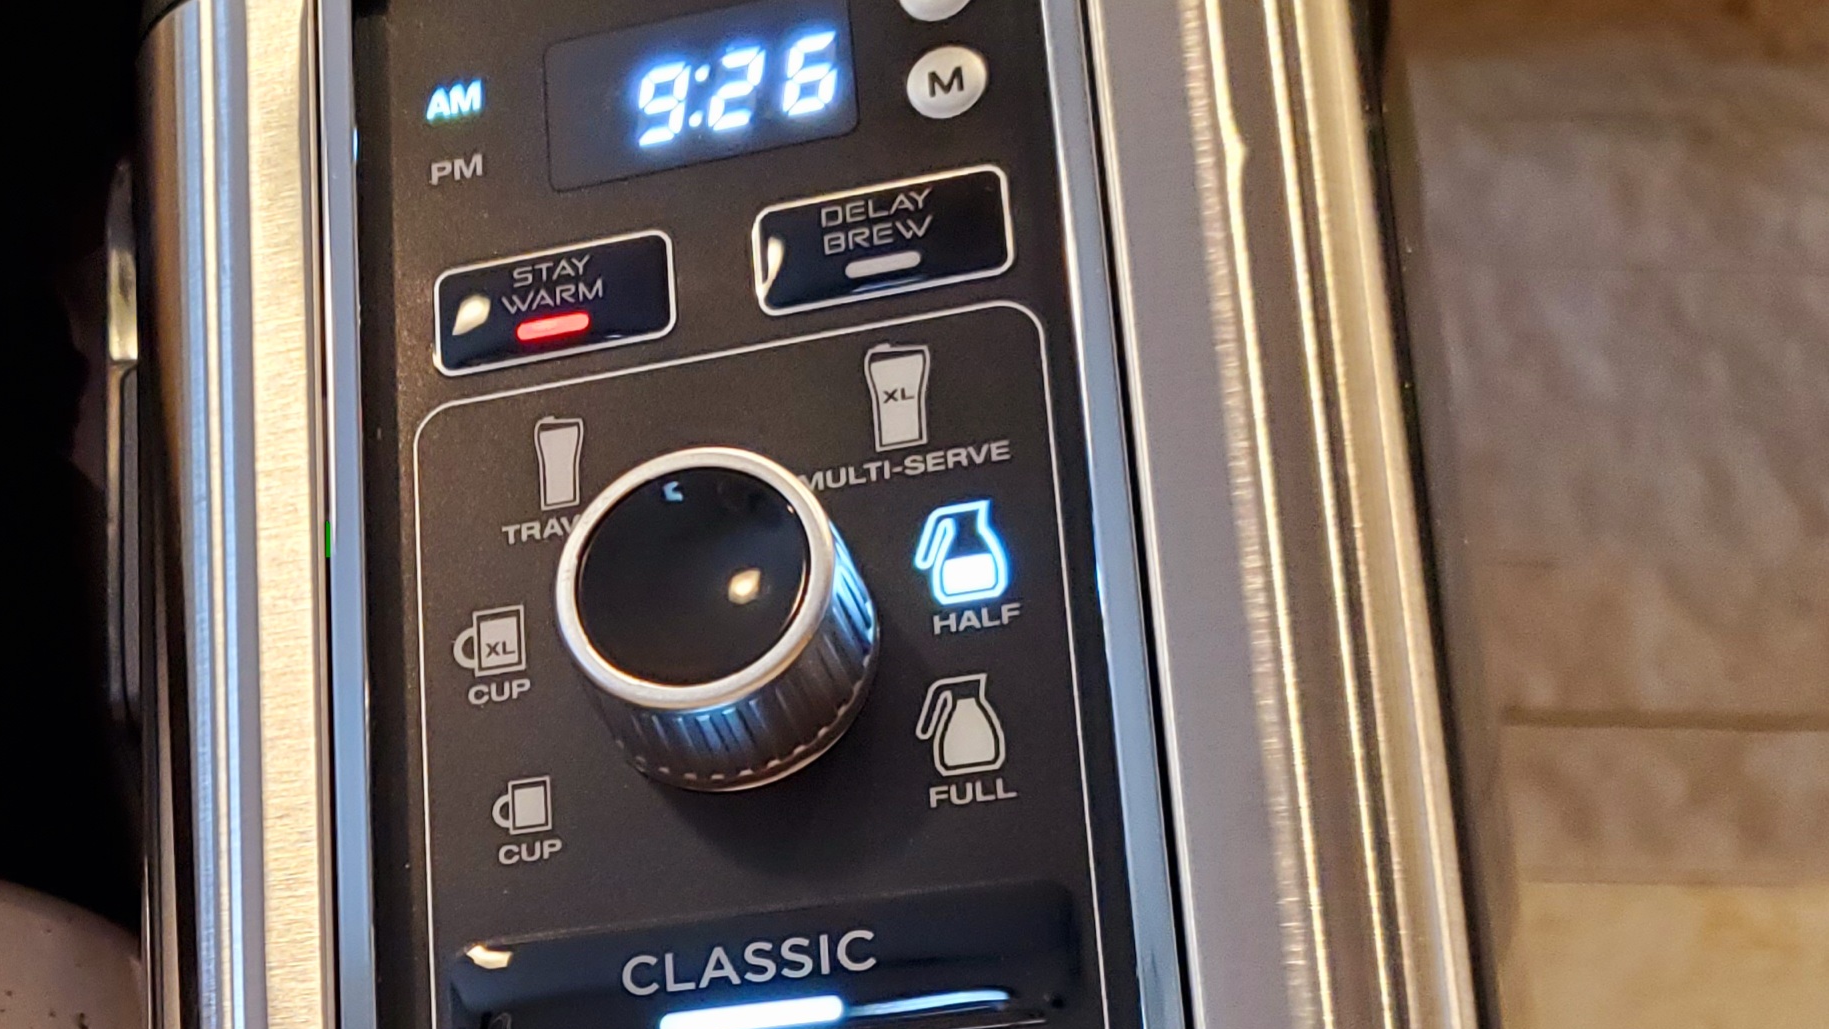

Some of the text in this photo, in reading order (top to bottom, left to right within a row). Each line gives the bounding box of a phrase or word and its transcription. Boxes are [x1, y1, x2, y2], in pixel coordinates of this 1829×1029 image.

[637, 30, 838, 149] 9:26
[927, 65, 965, 98] M
[426, 79, 483, 122] AM
[430, 154, 484, 185] PM
[820, 187, 934, 228] DELAY
[823, 214, 934, 256] BREW
[512, 254, 592, 288] STAY
[501, 277, 604, 315] WARM
[882, 387, 916, 404] XL
[799, 439, 1012, 492] MULTI-SERVE
[932, 602, 1021, 635] HALF
[485, 640, 517, 658] XL
[469, 677, 532, 706] CUP
[928, 776, 1018, 809] FULL
[498, 838, 563, 866] CUP
[621, 928, 877, 997] CLASSIC
